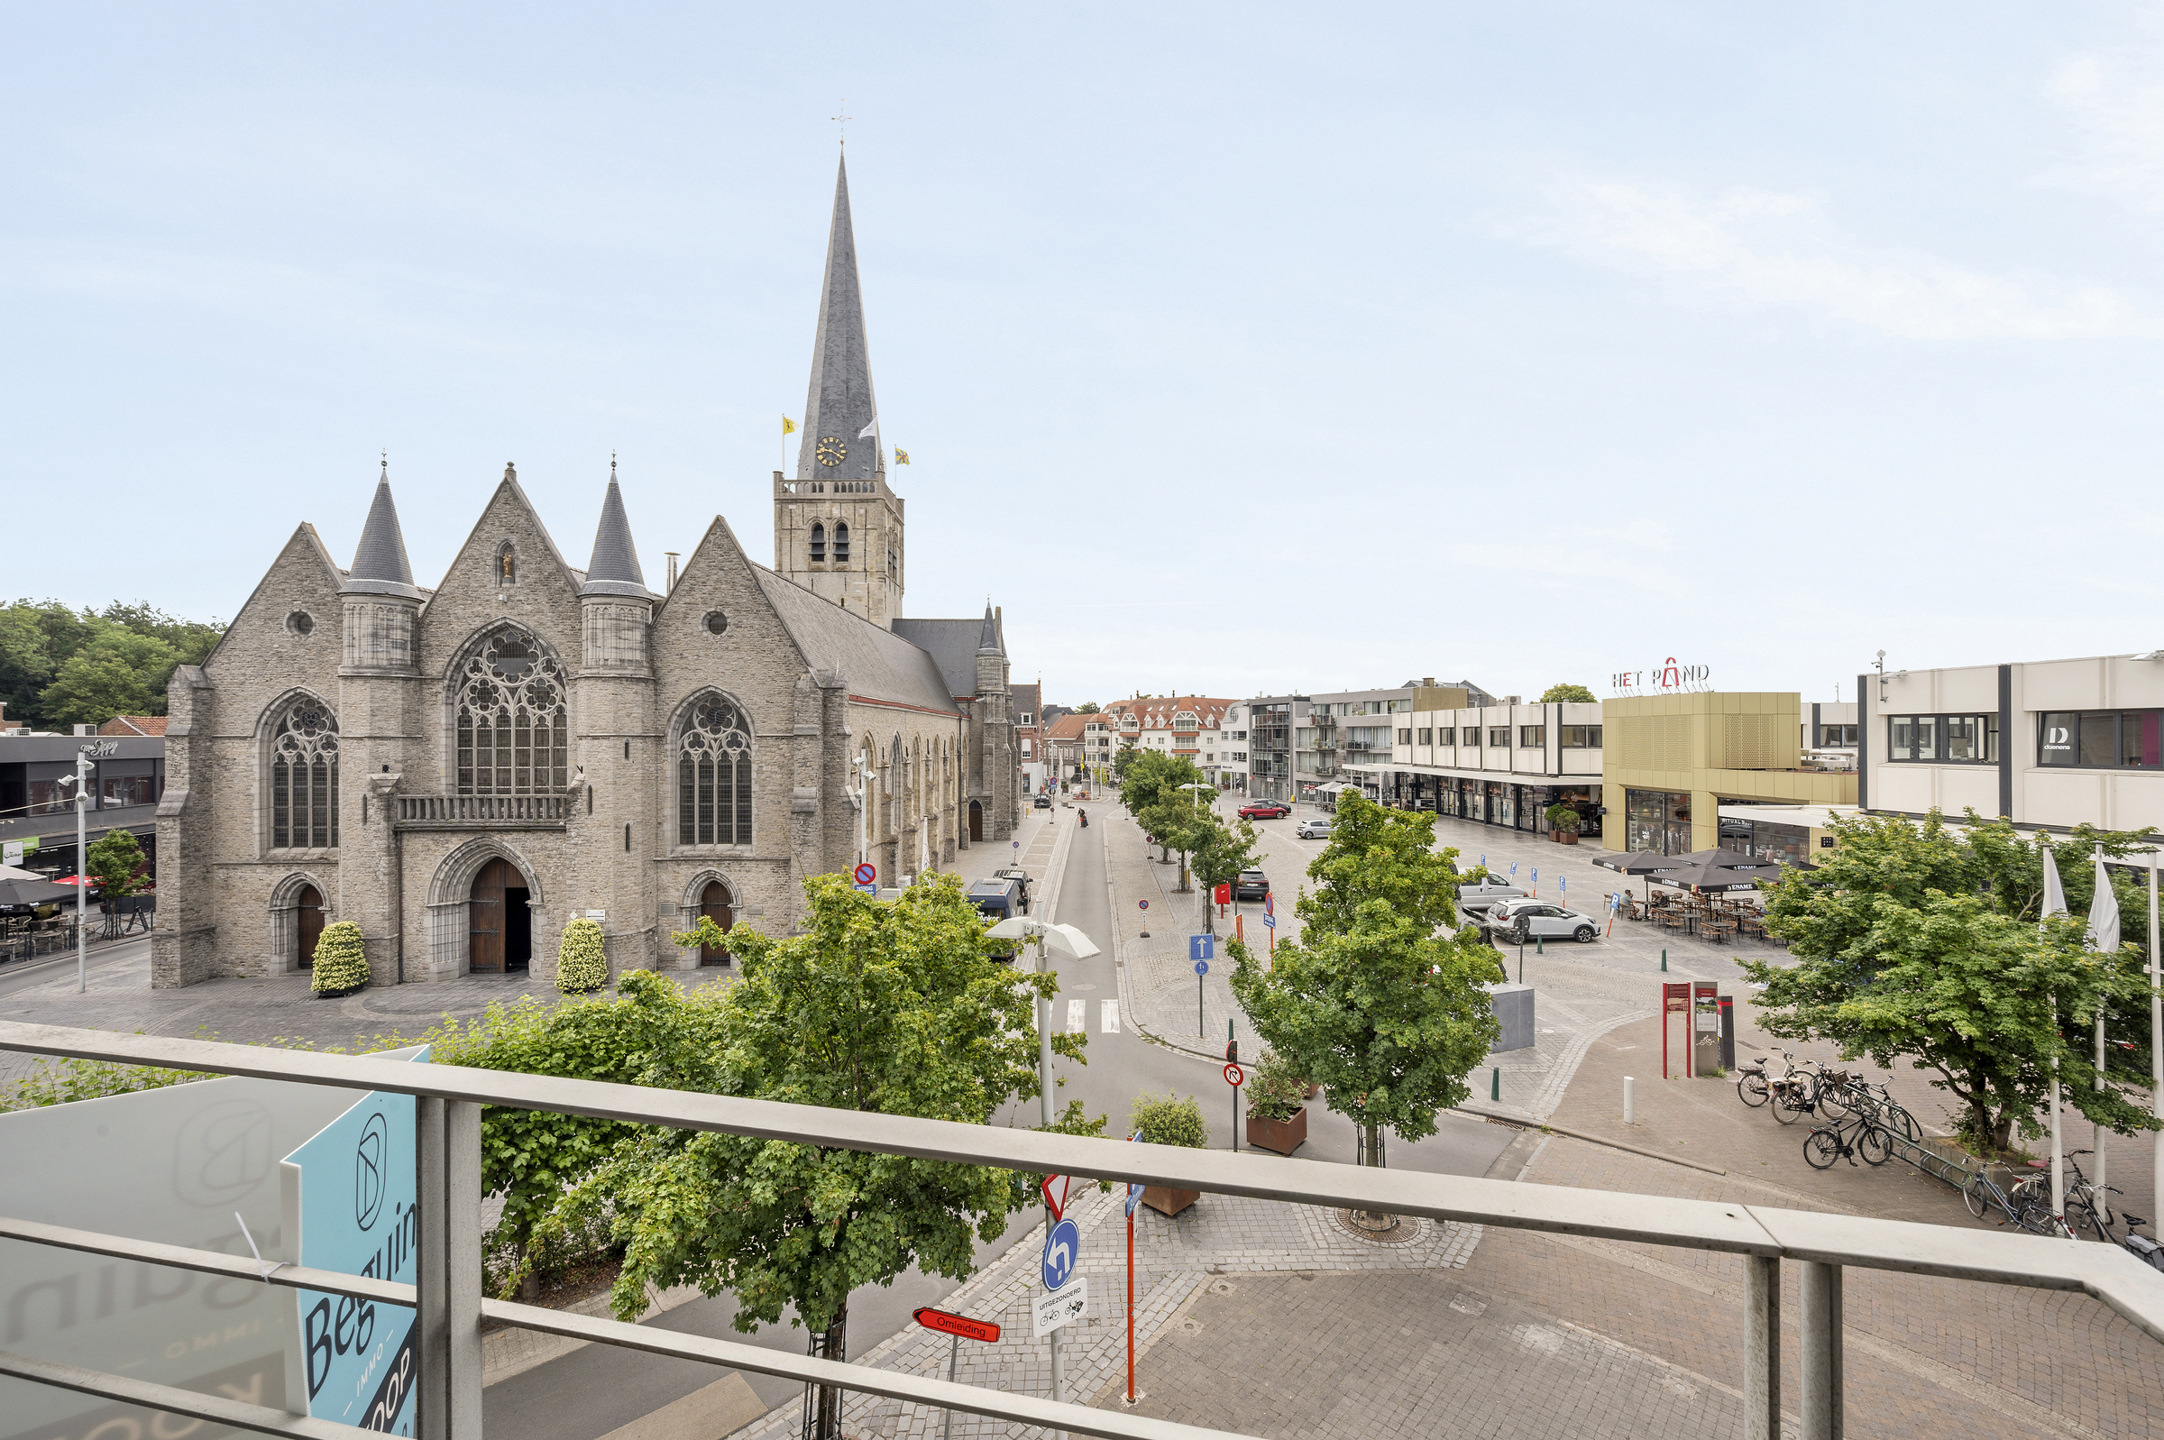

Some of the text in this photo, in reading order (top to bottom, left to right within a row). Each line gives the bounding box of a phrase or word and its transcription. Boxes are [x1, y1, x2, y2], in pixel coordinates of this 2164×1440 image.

[1612, 671, 1642, 688] HET
[2049, 727, 2069, 744] D
[1611, 894, 1619, 905] P
[305, 1201, 417, 1403] Beguin
[1039, 1287, 1081, 1310] UITGEZONDERD
[936, 1316, 986, 1338] Omleiding
[356, 1342, 383, 1398] IMMO
[365, 1347, 410, 1433] OOP
